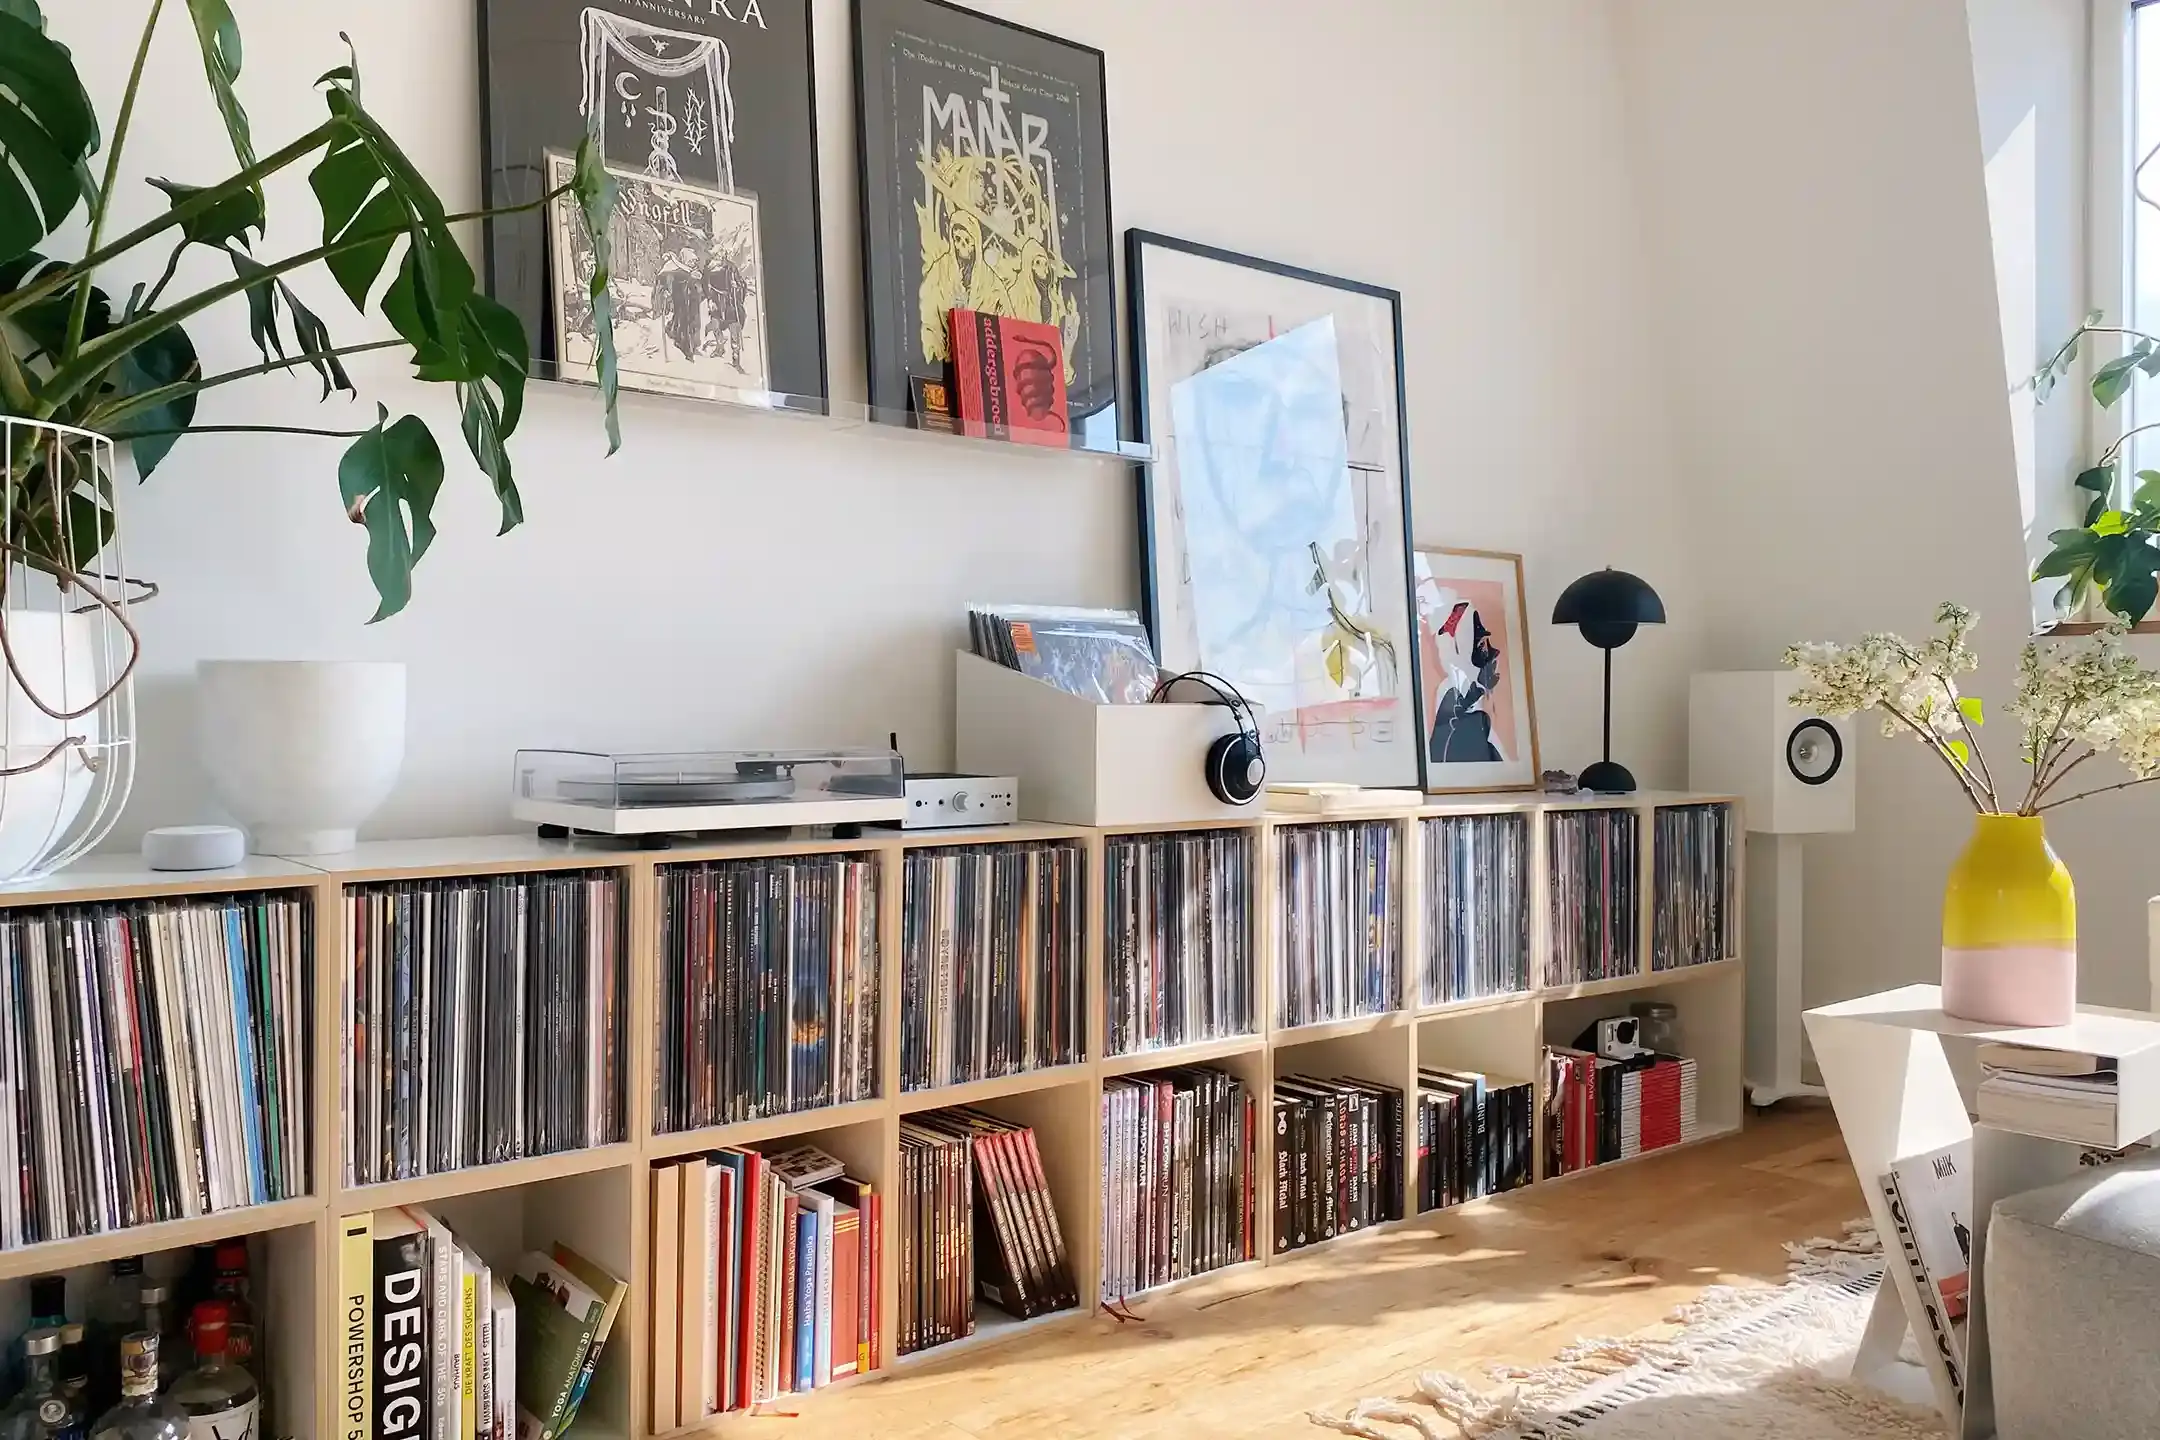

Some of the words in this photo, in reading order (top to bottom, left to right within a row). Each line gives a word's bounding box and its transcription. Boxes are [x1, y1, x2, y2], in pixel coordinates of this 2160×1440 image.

[633, 1, 707, 25] ANNIVERSARY
[1338, 1101, 1347, 1137] LORDS
[1477, 1102, 1486, 1134] BLIND
[1138, 1115, 1147, 1186] SHADOWRUN
[1161, 1121, 1171, 1197] SHADOWRUN
[1278, 1150, 1287, 1178] Black
[1931, 1153, 1957, 1180] MilK
[1278, 1181, 1288, 1209] Metal
[437, 1246, 448, 1284] STARS
[437, 1284, 447, 1307] AND
[804, 1277, 813, 1299] Yoga
[465, 1287, 473, 1328] SUCHENS
[803, 1300, 812, 1327] Hatha
[382, 1268, 422, 1440] DESIG
[437, 1343, 447, 1360] OF
[465, 1332, 473, 1349] DES
[347, 1295, 365, 1424] POWERSHOP
[437, 1361, 446, 1382] THE
[453, 1353, 461, 1390] BAUHAUS
[464, 1351, 473, 1378] KRAFT
[464, 1380, 473, 1396] DIE
[551, 1391, 568, 1419] YOGA
[563, 1345, 586, 1389] ANATOMIE
[580, 1331, 591, 1345] 3D
